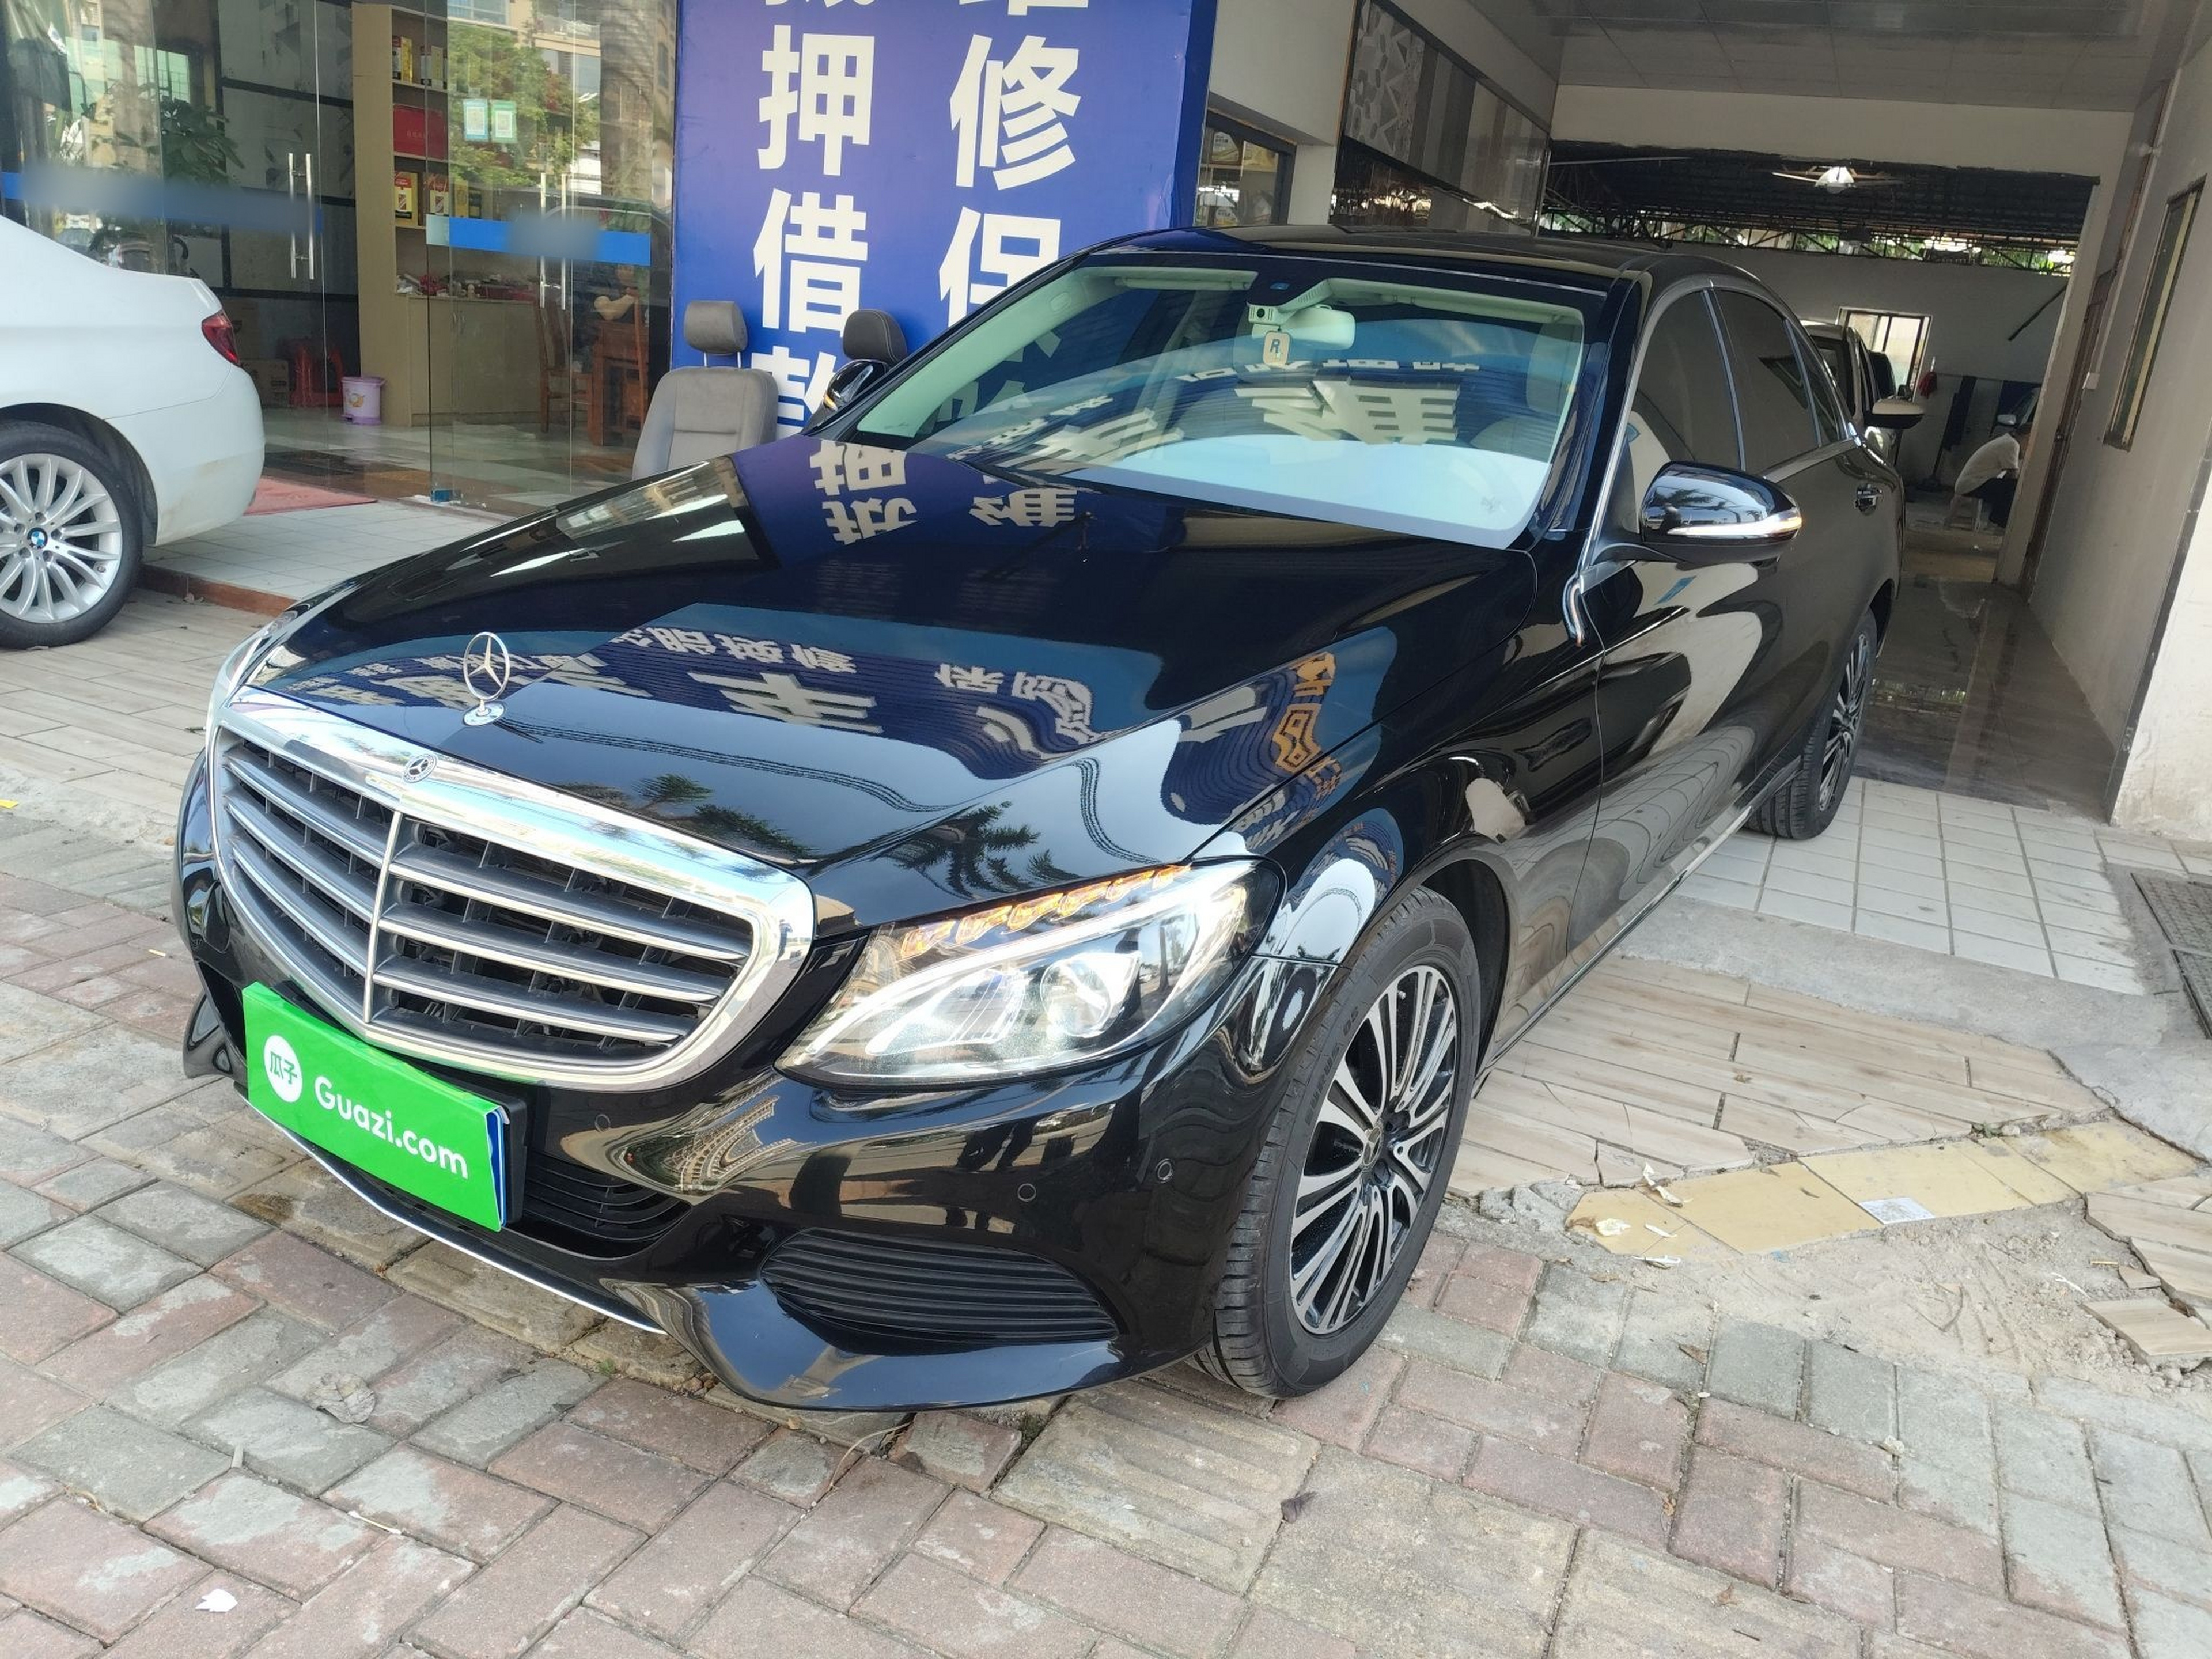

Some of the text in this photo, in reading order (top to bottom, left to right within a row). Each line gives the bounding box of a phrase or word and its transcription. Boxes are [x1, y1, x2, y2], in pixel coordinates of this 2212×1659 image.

[751, 0, 876, 438] 押借
[939, 0, 1088, 327] 修保
[269, 1050, 298, 1086] 瓜子
[314, 1075, 469, 1179] Guazi.com
